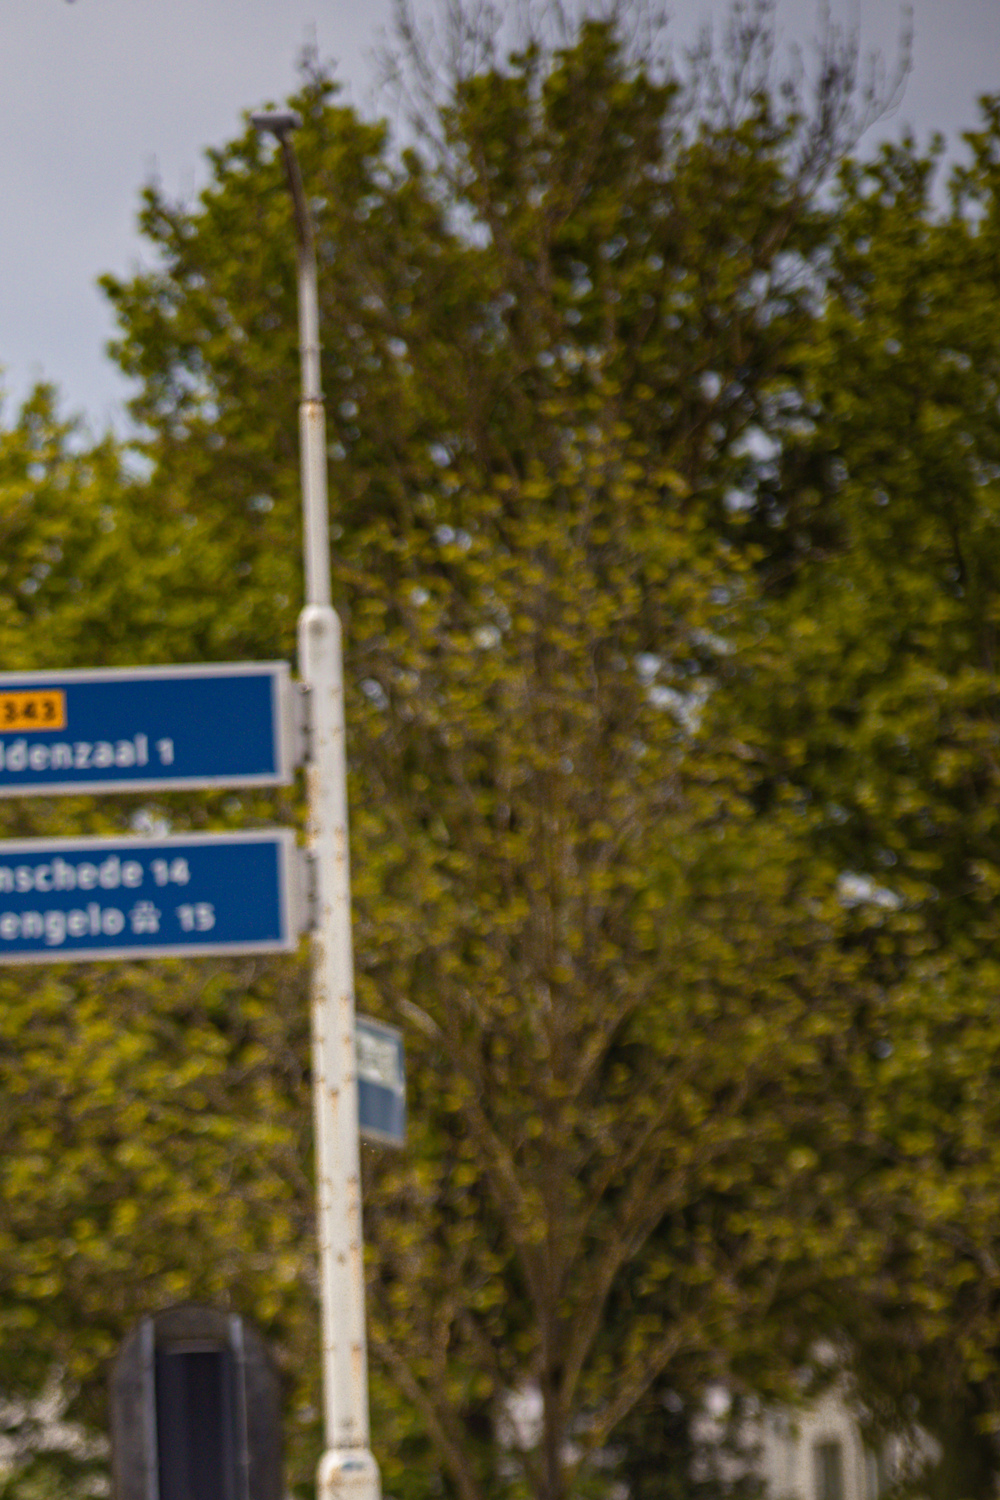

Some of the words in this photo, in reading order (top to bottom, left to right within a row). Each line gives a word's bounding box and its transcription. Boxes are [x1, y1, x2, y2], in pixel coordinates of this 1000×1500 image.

[158, 738, 176, 765] 1
[153, 859, 191, 887] 14
[178, 902, 217, 932] 15
